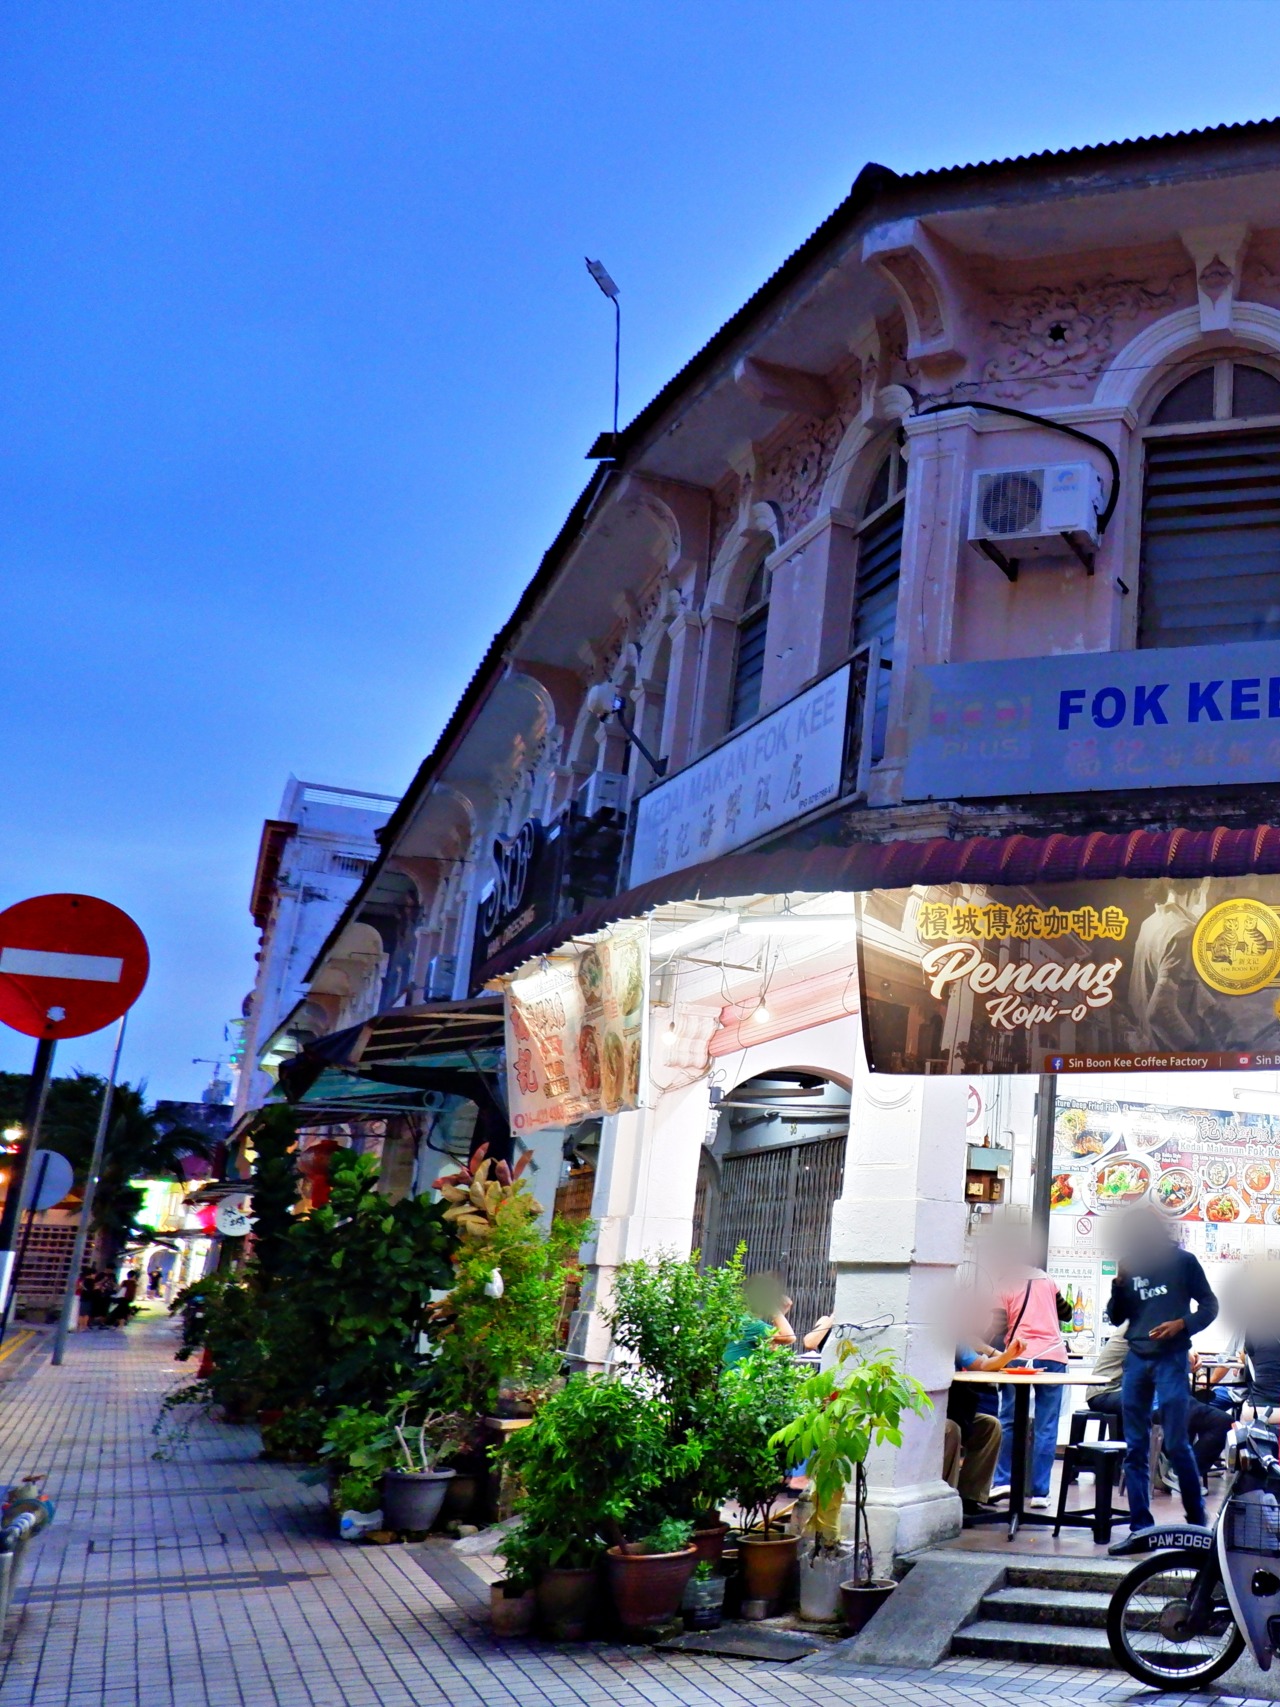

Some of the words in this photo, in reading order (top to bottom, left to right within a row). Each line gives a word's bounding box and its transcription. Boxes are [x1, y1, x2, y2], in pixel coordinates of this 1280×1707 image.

[1058, 684, 1171, 730] FOK
[643, 783, 686, 831] KEDAI
[688, 745, 748, 807] MAKAN
[753, 720, 789, 767] FOK
[797, 688, 836, 742] KEE
[921, 940, 1123, 1008] Penang
[1068, 1058, 1084, 1068] Sin
[1086, 1058, 1111, 1068] Boon
[1113, 1058, 1132, 1068] Kee
[1134, 1056, 1167, 1067] Coffee
[1170, 1056, 1208, 1069] Factory
[1255, 1055, 1272, 1066] Sin
[1056, 1099, 1070, 1108] ture
[1071, 1100, 1087, 1111] Deep
[1088, 1101, 1104, 1111] Fried
[1105, 1102, 1119, 1113] Fish
[1180, 1141, 1204, 1151] Kedai
[1206, 1143, 1245, 1155] Makanan
[1247, 1145, 1266, 1156] Fok
[1132, 1276, 1150, 1291] The
[1139, 1285, 1168, 1300] Boss
[1148, 1533, 1212, 1551] PAW3069
